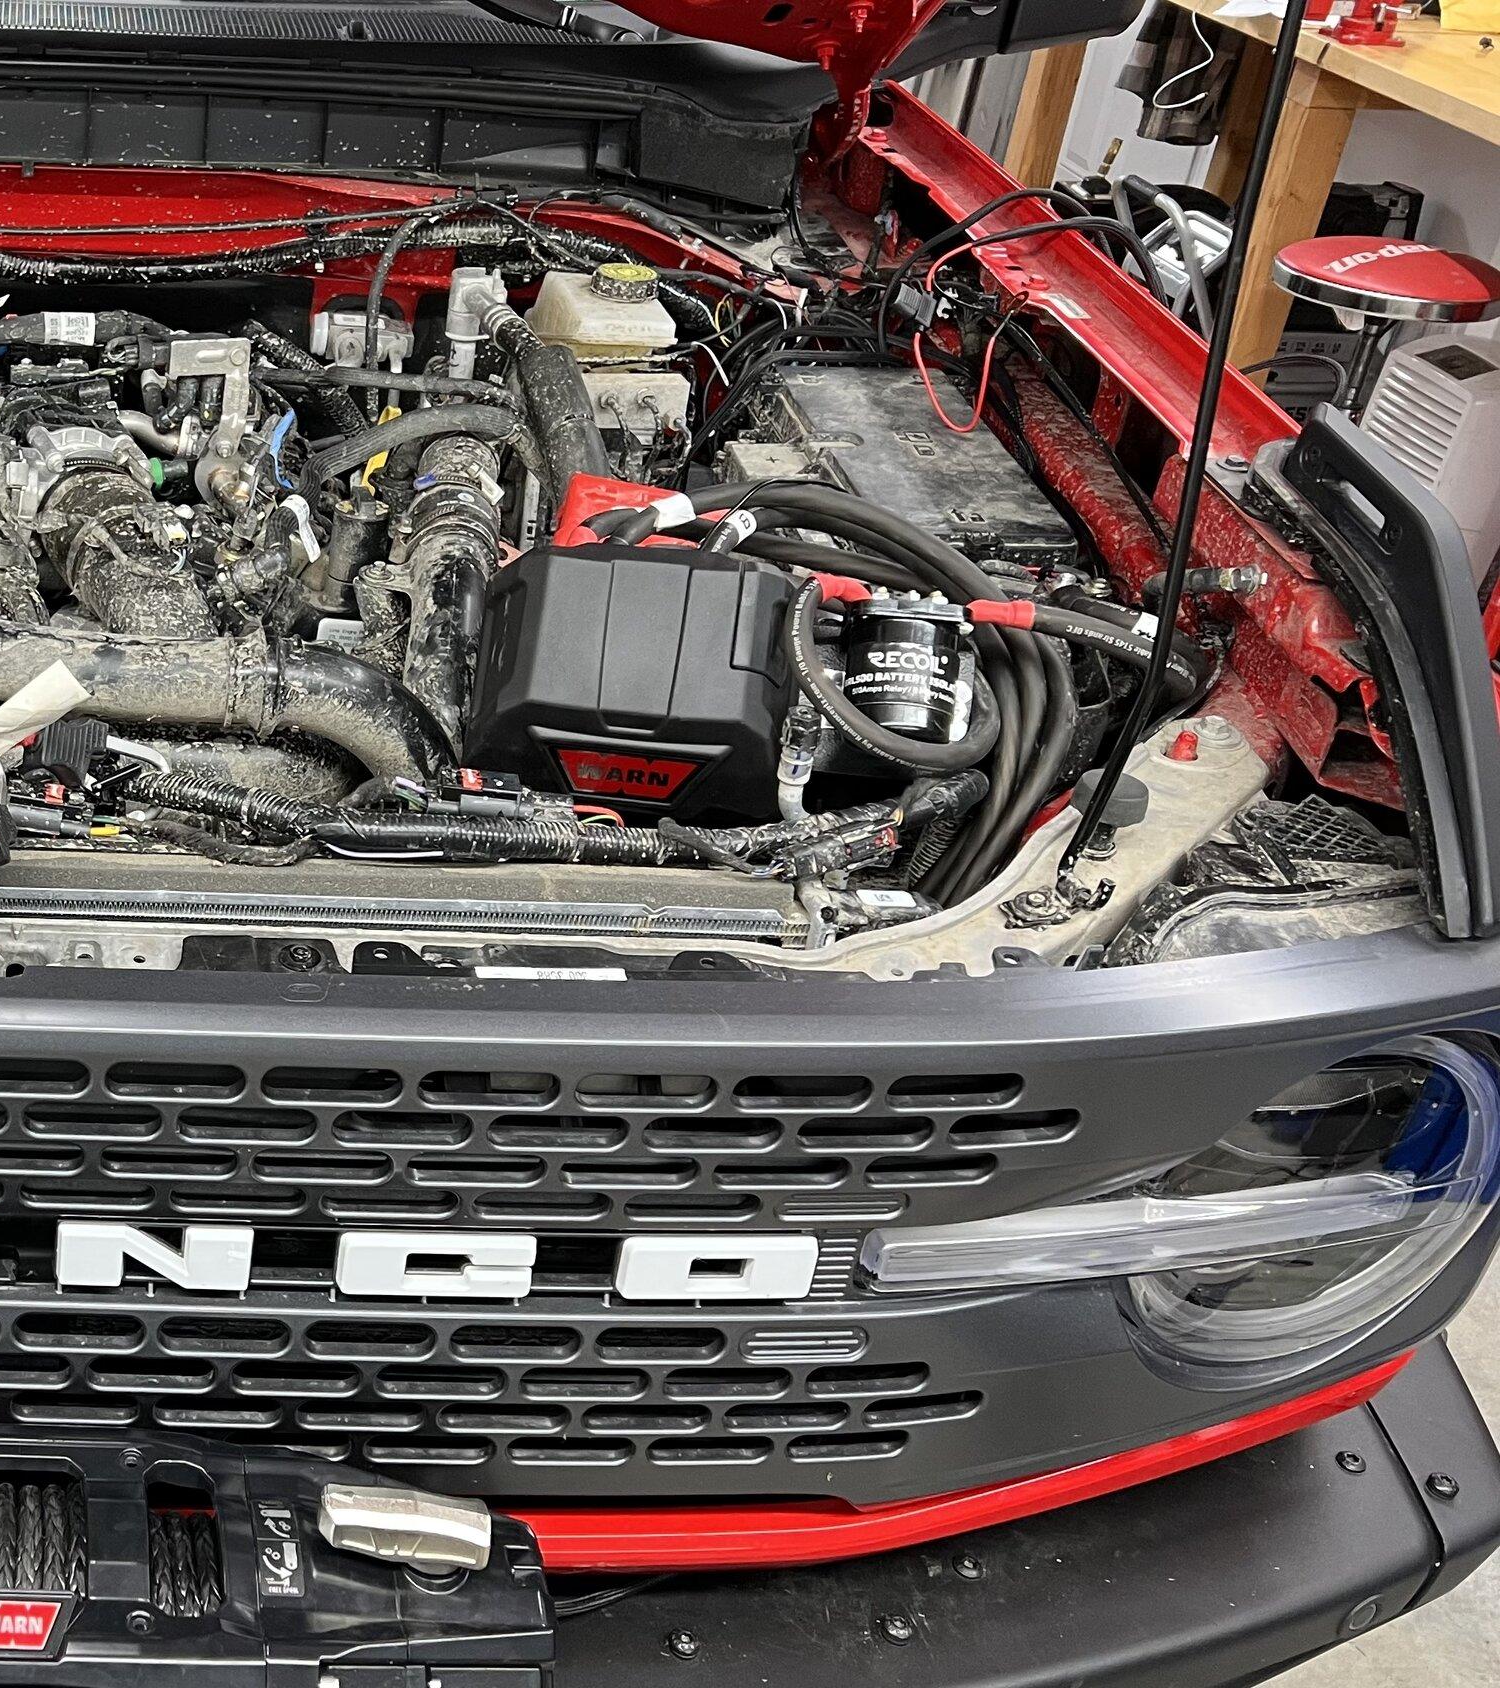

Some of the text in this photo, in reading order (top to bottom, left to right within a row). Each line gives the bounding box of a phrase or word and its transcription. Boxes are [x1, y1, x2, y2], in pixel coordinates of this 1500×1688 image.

[867, 651, 946, 675] RECOIL
[874, 671, 928, 685] BATTERY
[577, 762, 670, 787] WARN
